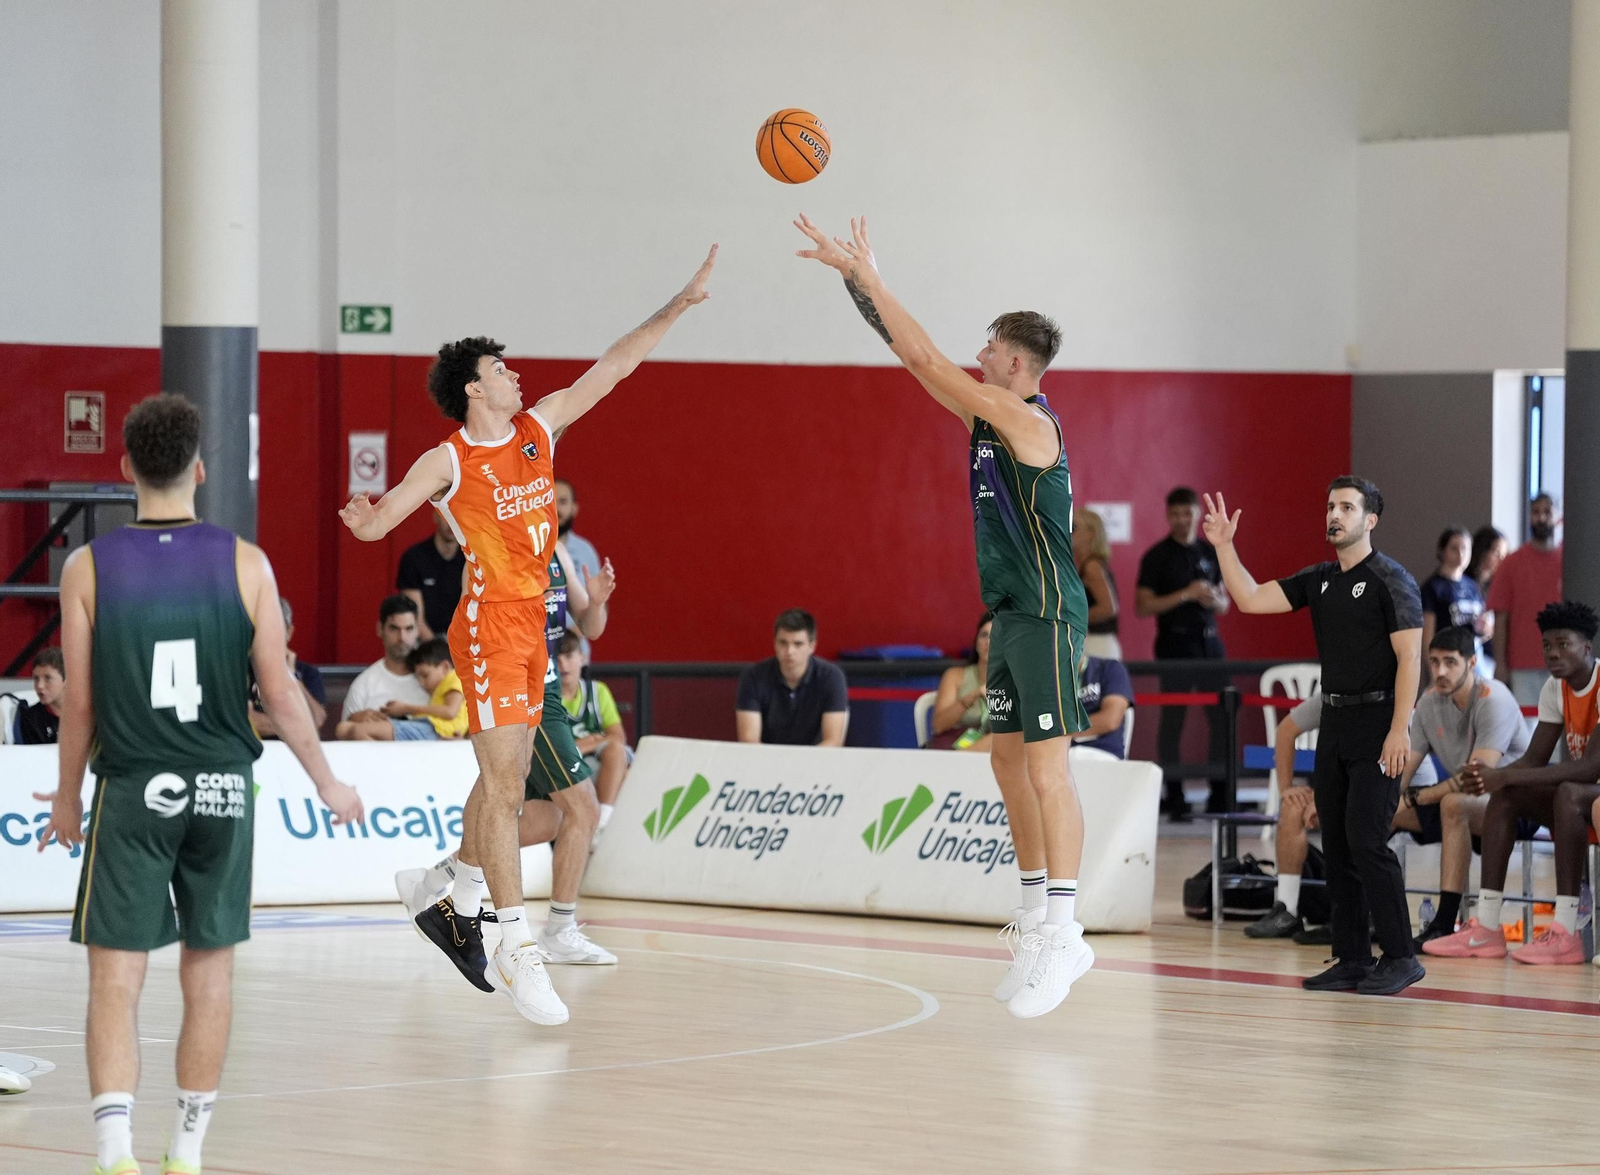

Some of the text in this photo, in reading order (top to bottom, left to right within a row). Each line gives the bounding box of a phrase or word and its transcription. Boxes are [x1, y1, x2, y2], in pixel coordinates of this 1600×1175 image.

[800, 131, 829, 169] Wilson
[978, 490, 995, 498] orre
[527, 522, 551, 556] 10
[150, 638, 203, 723] 4
[195, 772, 246, 792] COSTA
[195, 789, 226, 805] DEL
[711, 781, 844, 817] Fundación
[695, 816, 789, 861] Unicaja
[917, 827, 1016, 875] Unicaja
